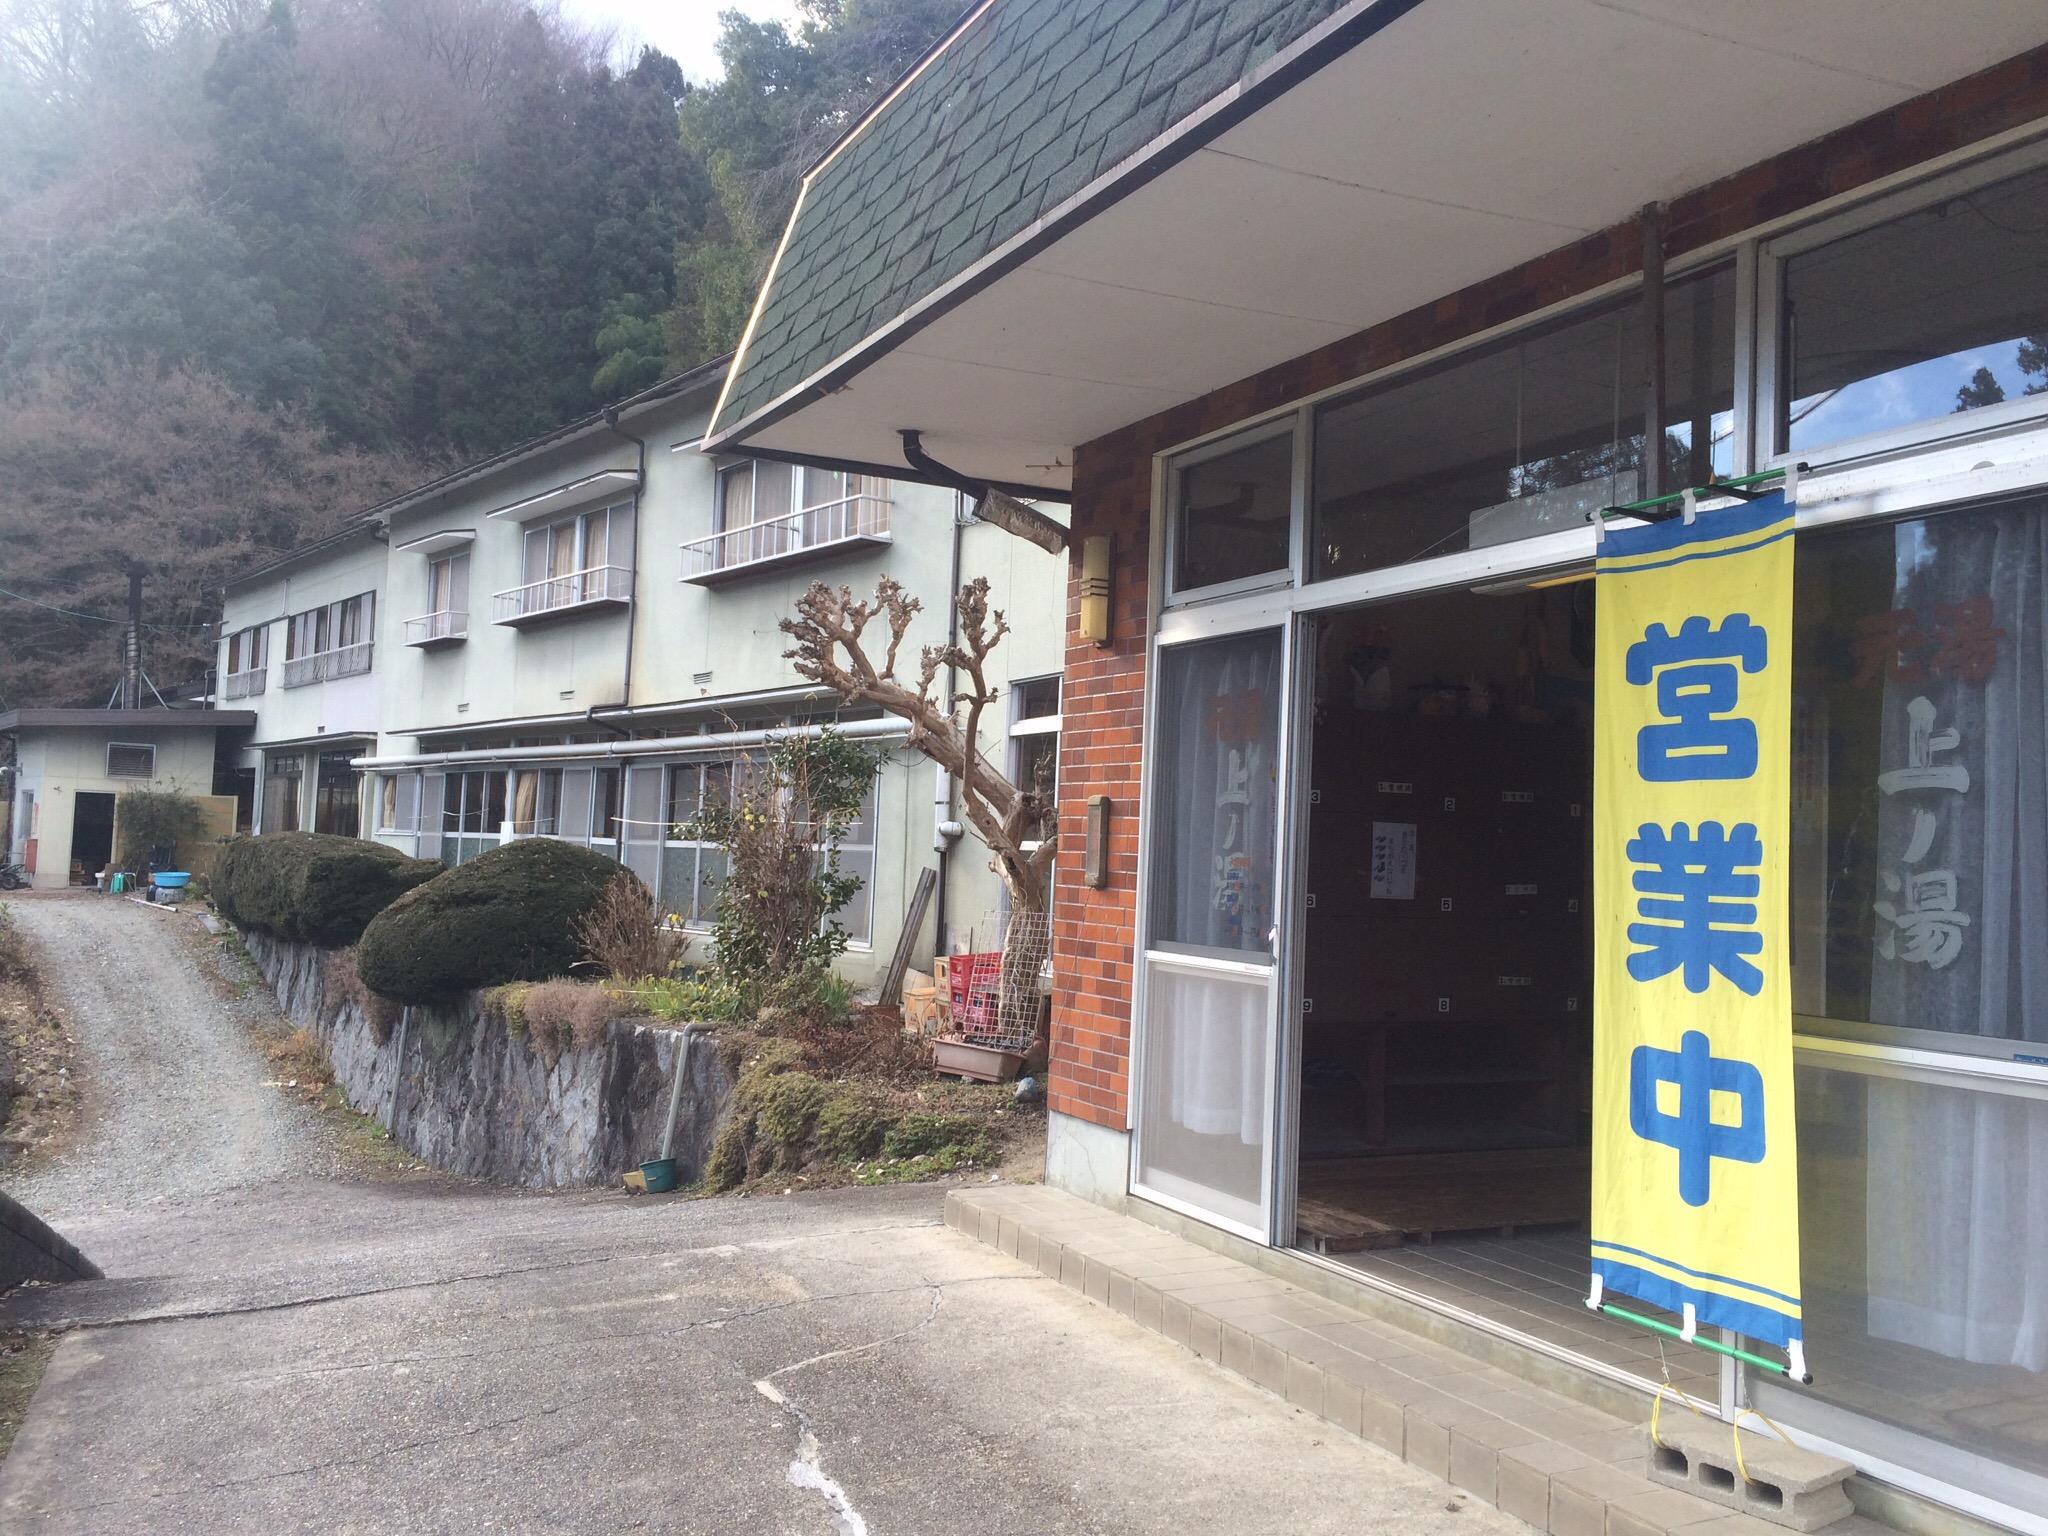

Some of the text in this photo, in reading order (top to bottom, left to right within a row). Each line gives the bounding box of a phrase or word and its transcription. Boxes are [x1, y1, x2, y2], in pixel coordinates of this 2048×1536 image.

[1625, 613, 1767, 1206] 営業中
[1873, 695, 1971, 969] 上ノ湯
